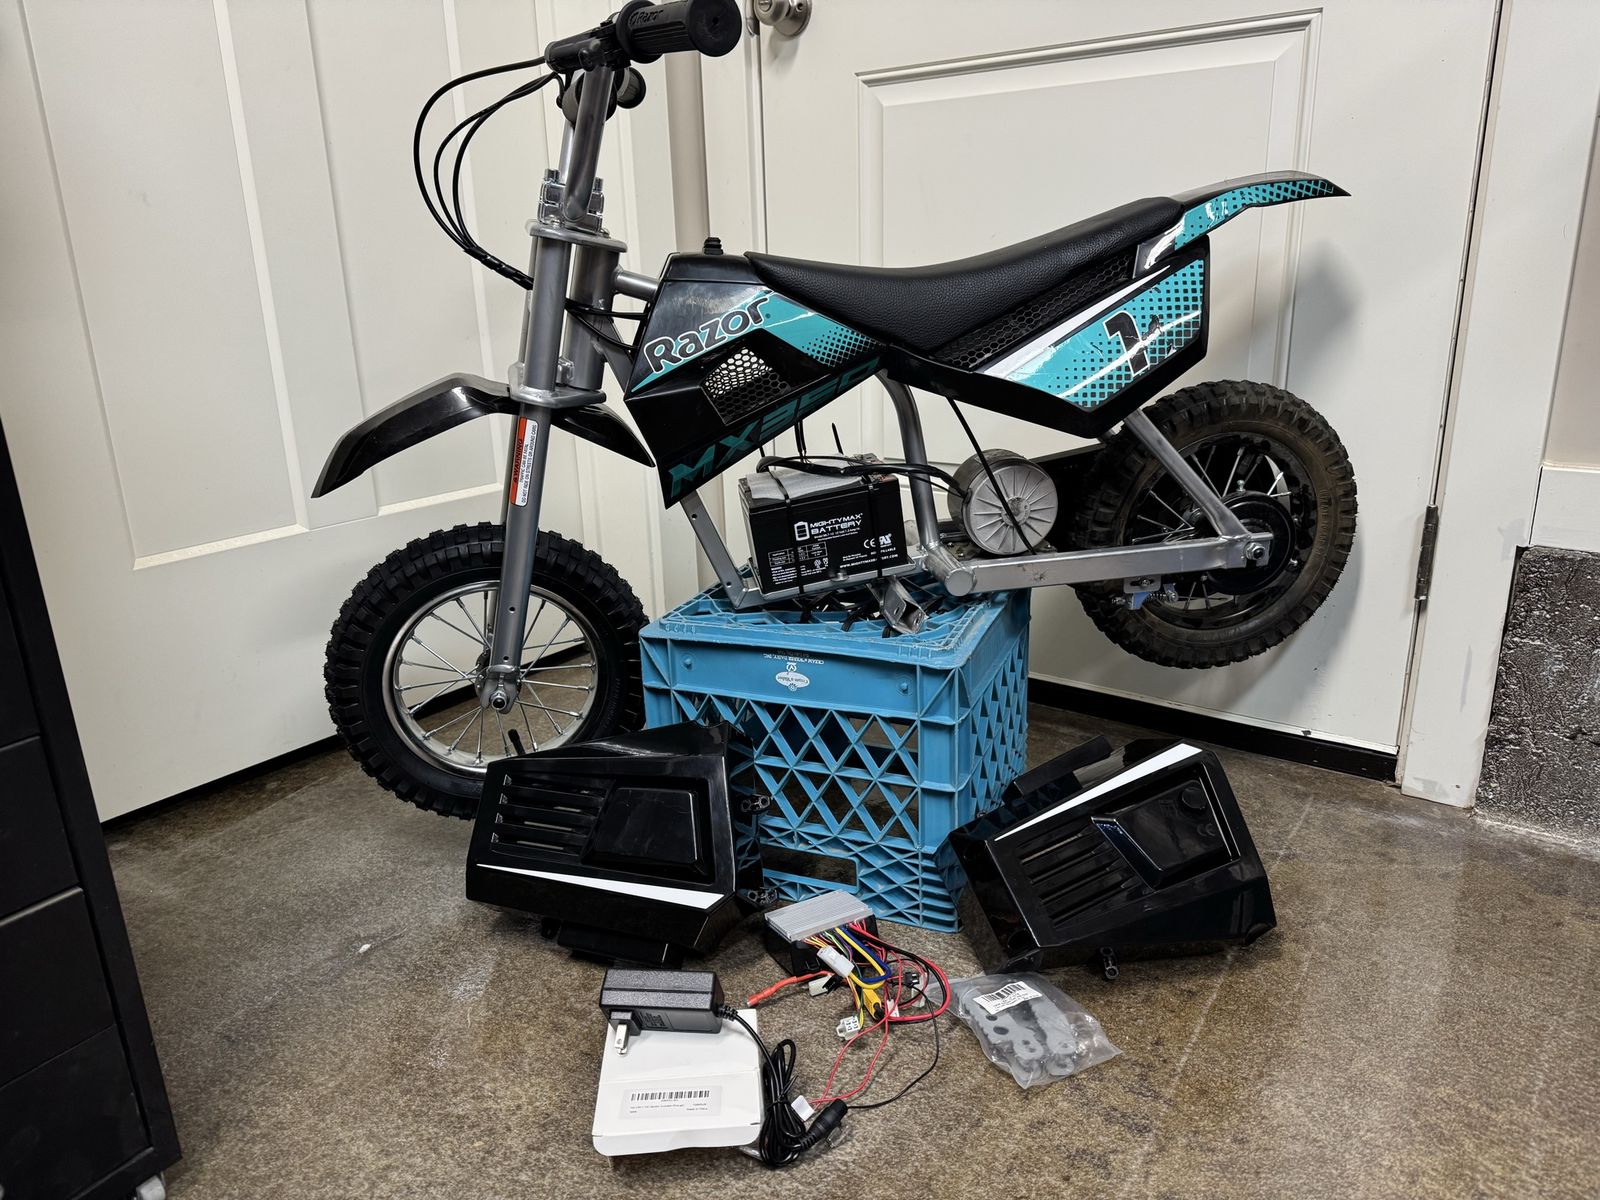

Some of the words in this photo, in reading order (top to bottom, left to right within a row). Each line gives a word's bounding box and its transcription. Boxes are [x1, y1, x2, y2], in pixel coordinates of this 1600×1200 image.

[643, 296, 769, 373] Razor
[1103, 310, 1150, 377] 1
[514, 439, 523, 476] WARNING
[668, 357, 879, 498] MX350
[811, 520, 861, 535] BATTERY
